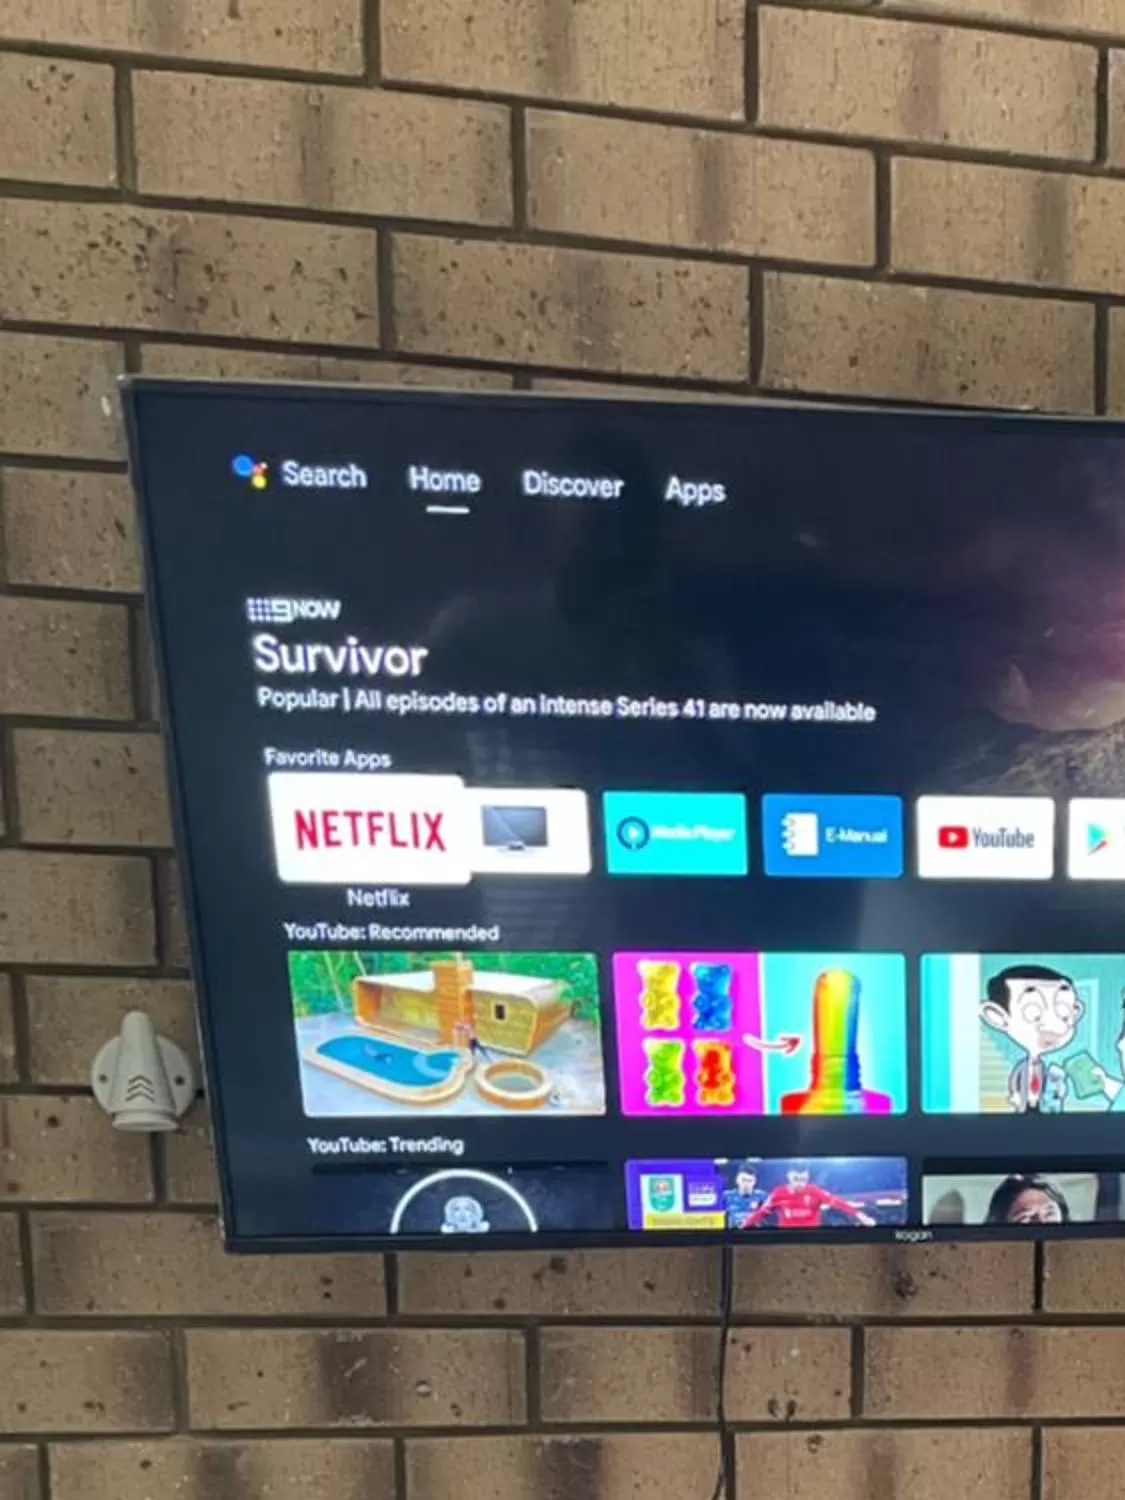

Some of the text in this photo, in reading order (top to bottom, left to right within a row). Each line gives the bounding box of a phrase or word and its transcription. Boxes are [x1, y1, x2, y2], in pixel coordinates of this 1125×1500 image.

[281, 459, 727, 507] Search Home Discover Apps
[252, 634, 427, 676] Survivor
[256, 686, 338, 711] Popular
[355, 688, 382, 710] All
[386, 691, 479, 715] episodes
[483, 692, 506, 713] of
[510, 695, 537, 714] an
[540, 693, 613, 716] intense
[616, 695, 679, 719] Series
[682, 698, 705, 717] 41
[708, 701, 740, 720] are
[744, 703, 787, 722] now
[791, 701, 877, 723] available
[264, 747, 392, 771] Favorite Apps
[294, 809, 447, 853] NETFLIX
[825, 827, 888, 844] E-Manual
[972, 826, 1035, 849] YouTube
[346, 888, 411, 908] Netflix
[283, 921, 501, 943] YouTube: Recommended
[306, 1136, 465, 1157] YouTube: Trending
[894, 1229, 933, 1242] kogan
